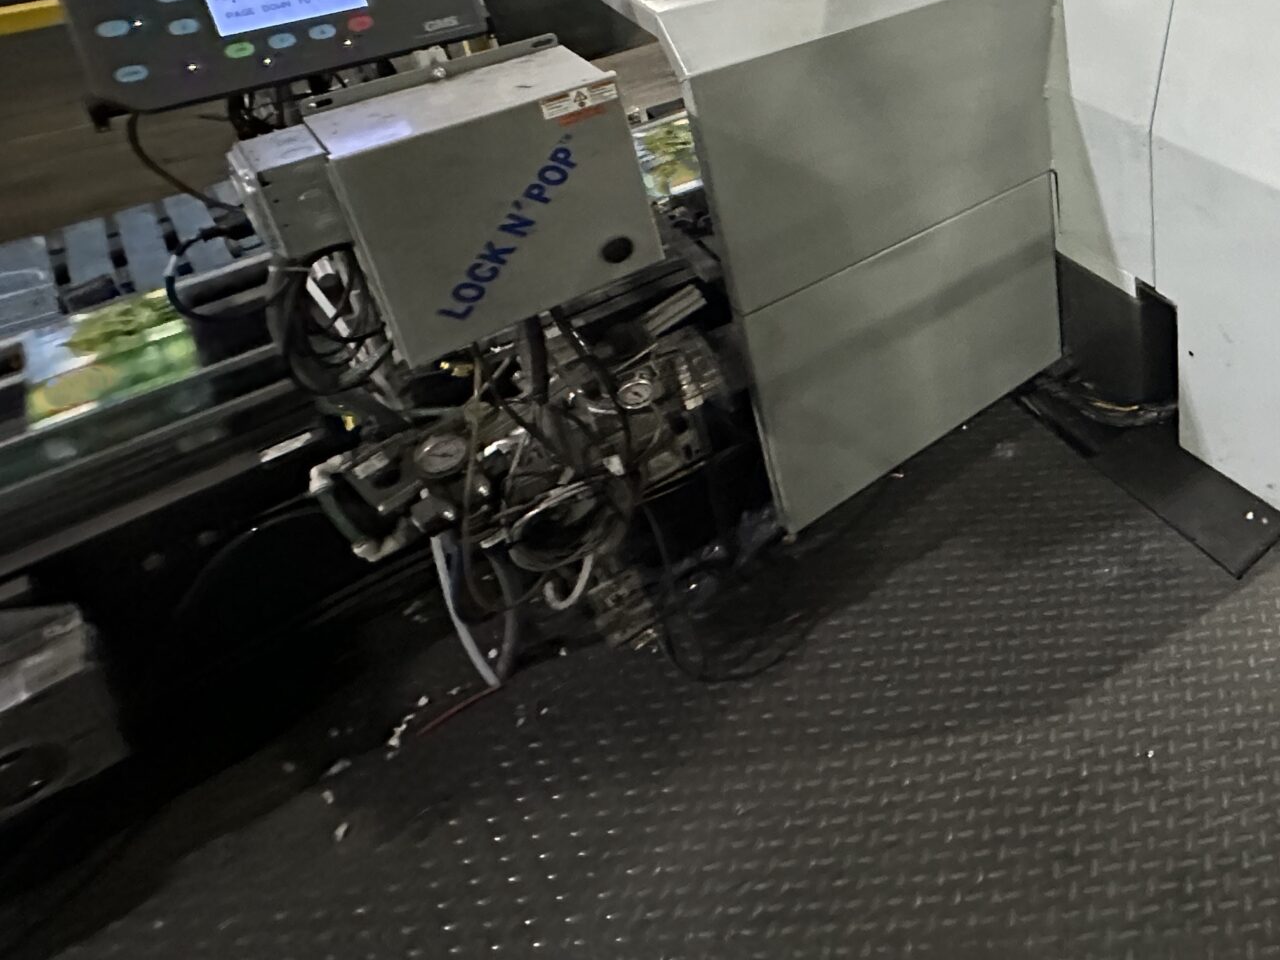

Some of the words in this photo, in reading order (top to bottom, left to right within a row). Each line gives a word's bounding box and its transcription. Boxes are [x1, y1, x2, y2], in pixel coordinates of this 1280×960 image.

[225, 7, 256, 20] PAGE
[261, 0, 292, 13] DOWN
[435, 240, 518, 320] LOCK
